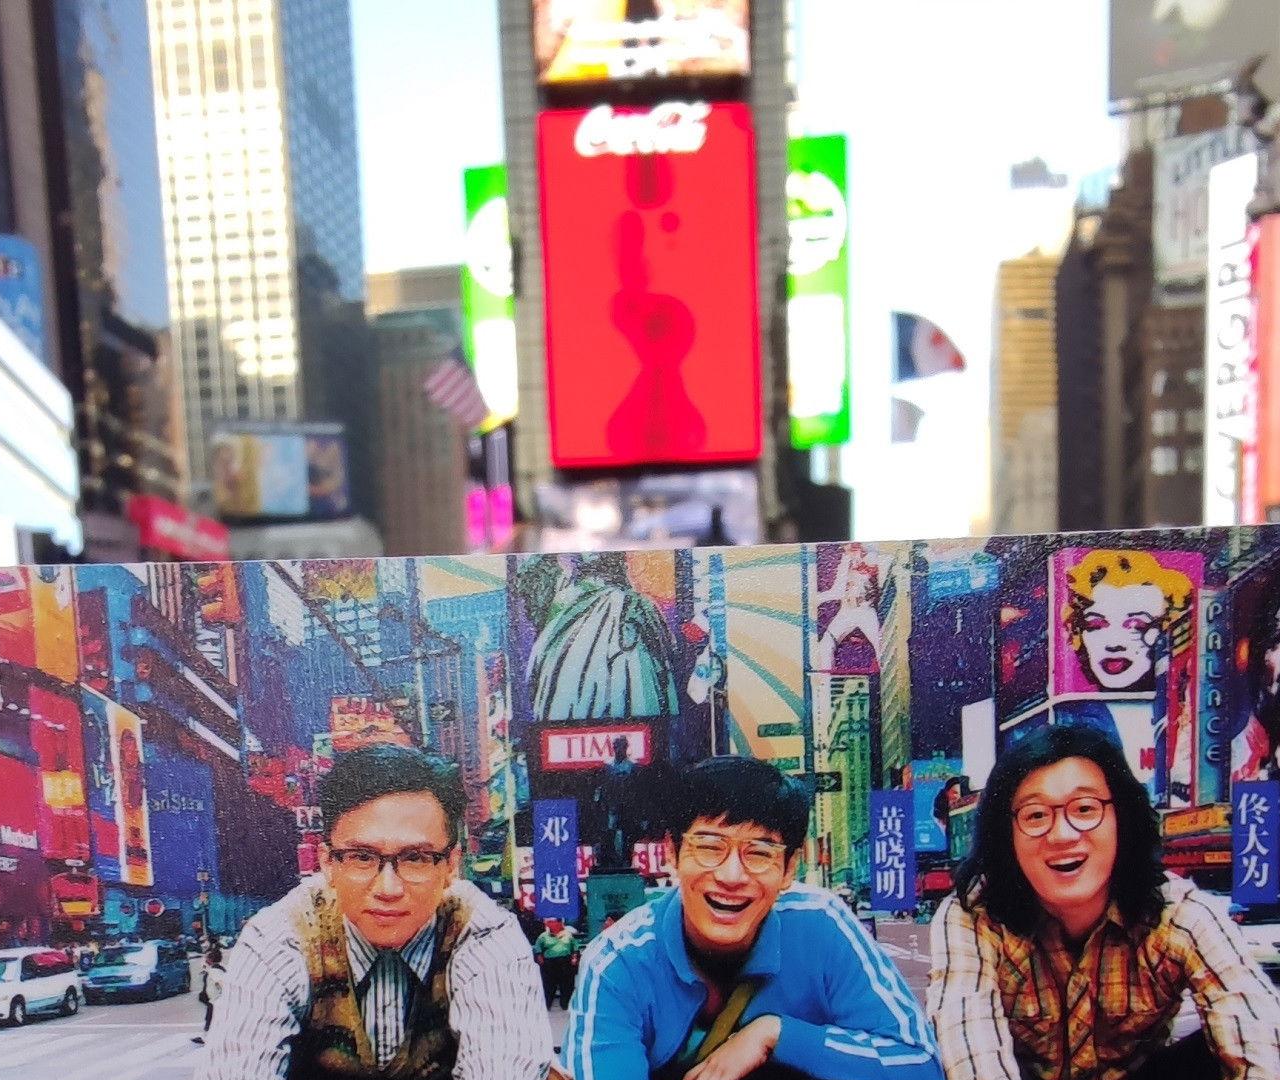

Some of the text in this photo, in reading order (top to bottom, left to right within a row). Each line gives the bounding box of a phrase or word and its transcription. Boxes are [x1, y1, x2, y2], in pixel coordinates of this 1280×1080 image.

[1206, 600, 1223, 763] PALACE
[558, 733, 641, 766] TIM
[1, 824, 38, 850] Mutual
[538, 815, 571, 904] 邓超
[874, 805, 907, 900] 黄晓明
[1236, 792, 1272, 888] 佟大为
